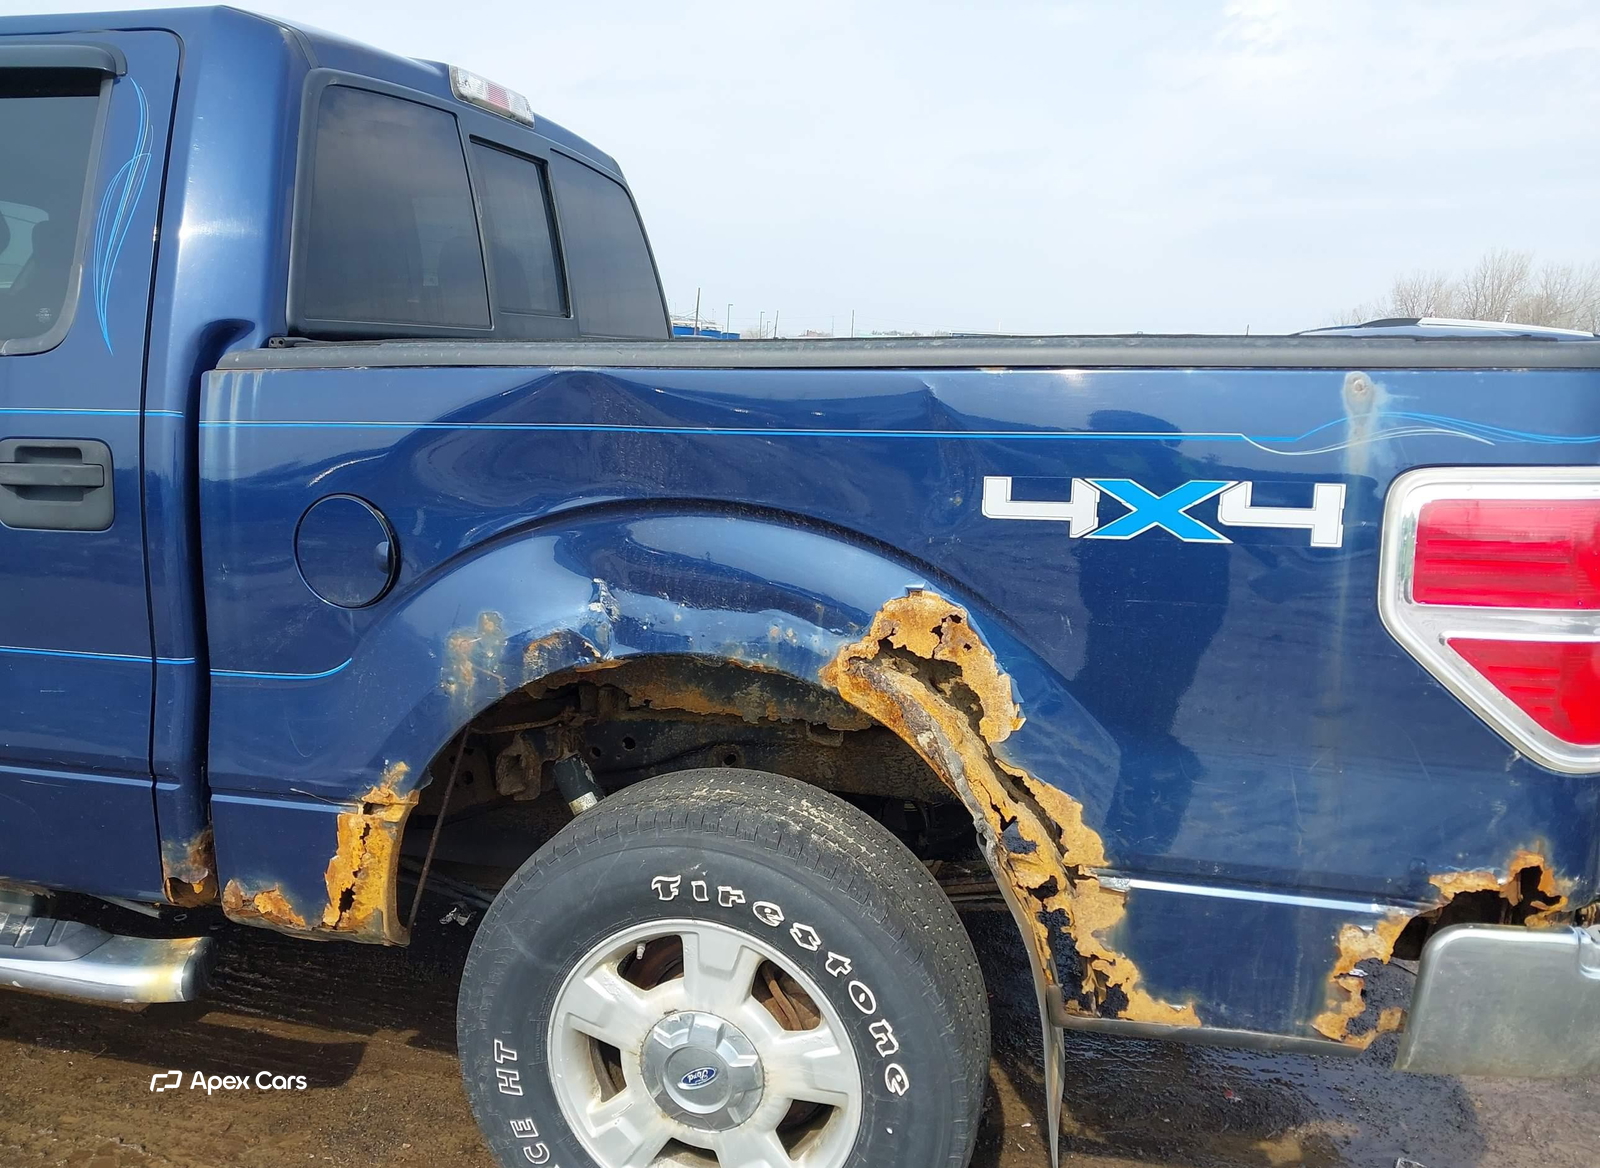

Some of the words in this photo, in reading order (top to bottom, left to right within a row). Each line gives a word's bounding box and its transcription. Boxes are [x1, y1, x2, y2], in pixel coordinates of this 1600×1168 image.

[982, 475, 1347, 548] 4X4
[651, 874, 910, 1097] Firestone
[493, 1038, 524, 1096] HT
[687, 1069, 709, 1083] Ford
[509, 1117, 562, 1168] CE
